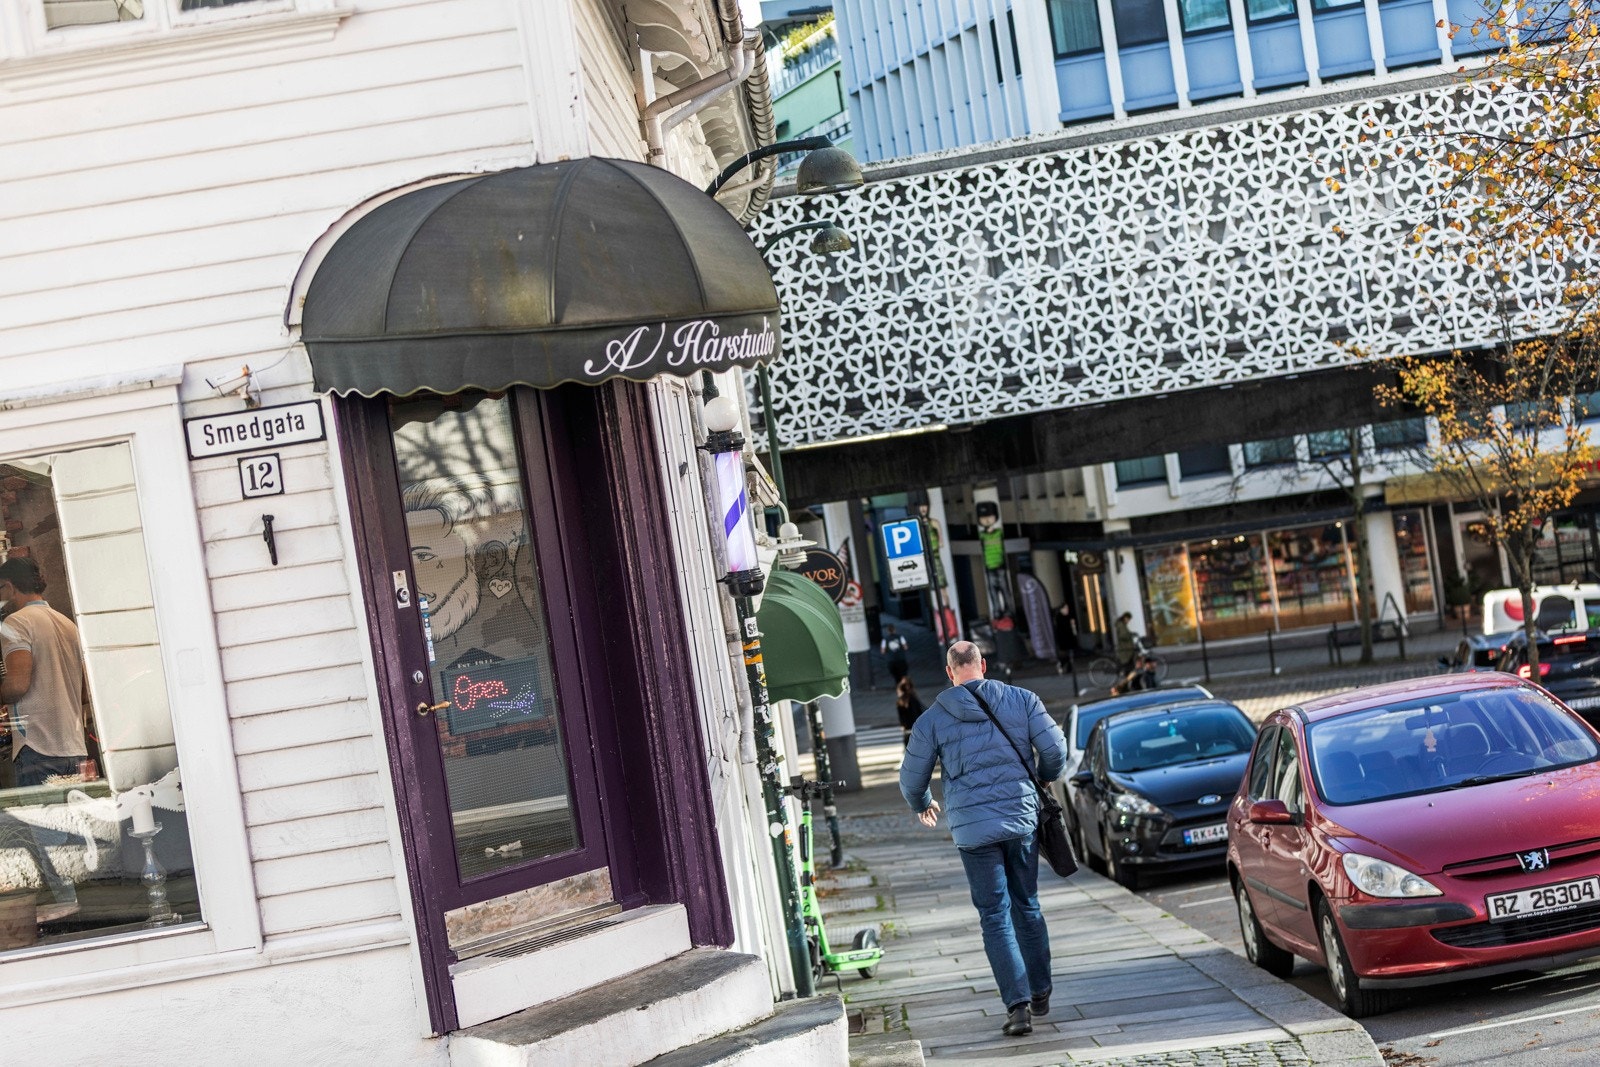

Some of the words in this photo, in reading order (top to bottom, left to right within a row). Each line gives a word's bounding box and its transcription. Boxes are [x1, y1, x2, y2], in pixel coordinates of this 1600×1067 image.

[666, 316, 776, 366] Hårstudio
[203, 412, 305, 446] Smedgata
[246, 462, 275, 491] 12
[891, 526, 912, 555] P
[489, 582, 510, 592] MOM
[455, 675, 509, 711] Open
[1193, 829, 1207, 841] RK
[1493, 894, 1520, 916] RZ
[1530, 881, 1595, 910] 26304
[1516, 904, 1578, 919] www.toyota-oslo.no
